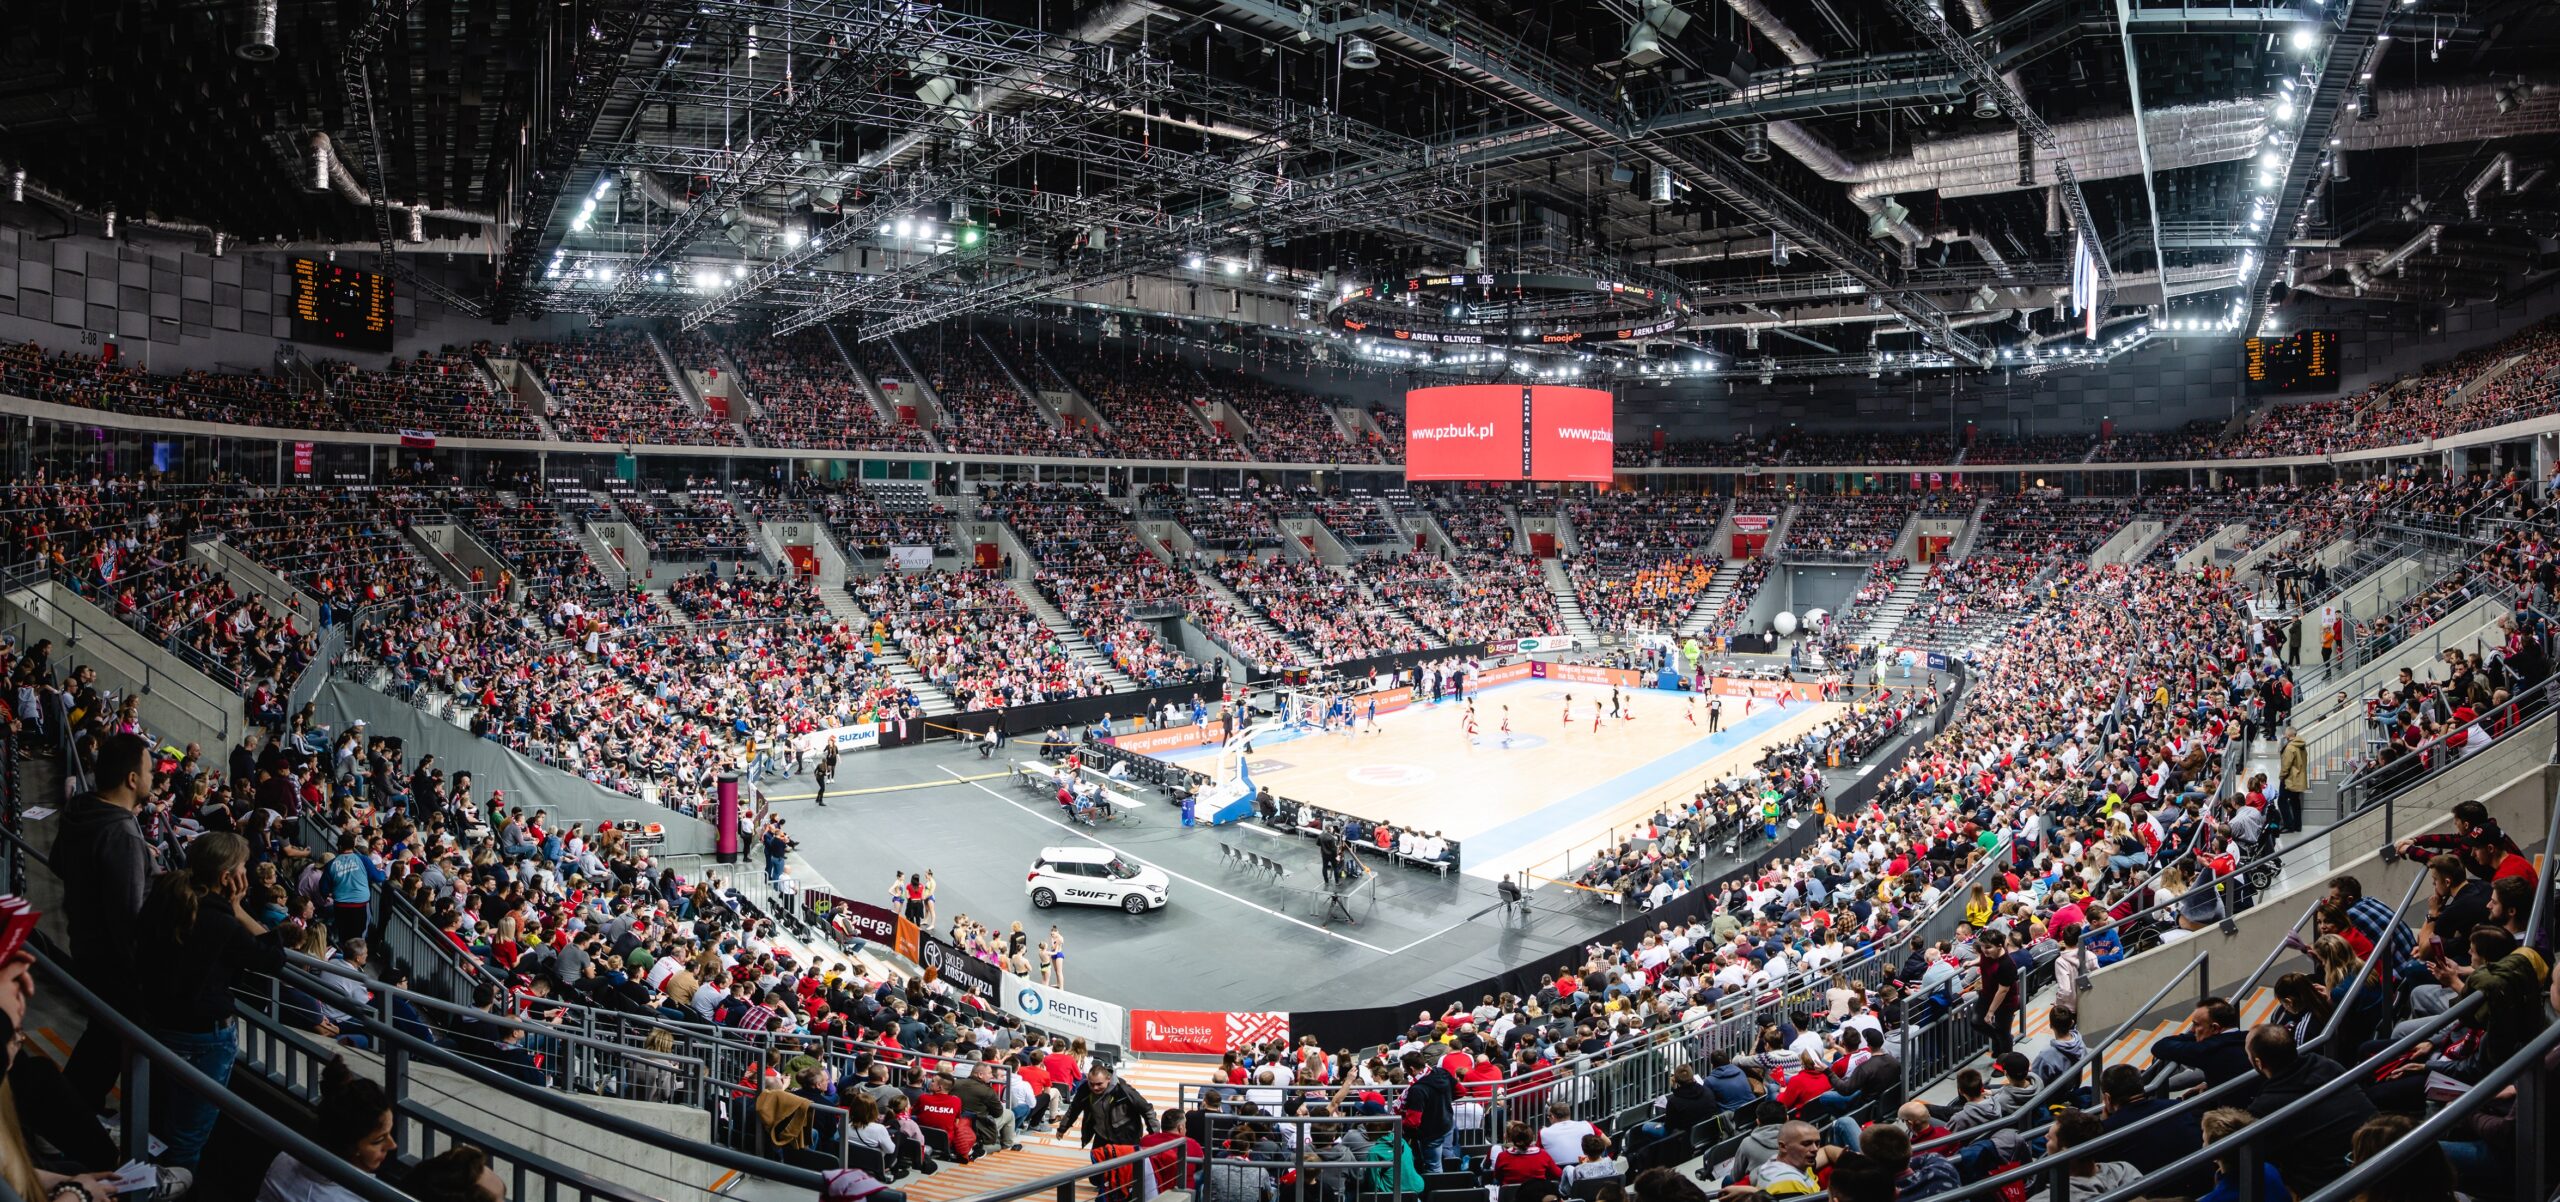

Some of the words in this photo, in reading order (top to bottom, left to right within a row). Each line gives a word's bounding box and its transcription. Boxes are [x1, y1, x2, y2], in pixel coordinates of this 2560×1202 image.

[1427, 277, 1450, 285] ISRAEL
[1477, 275, 1494, 285] 1:06
[1383, 284, 1389, 294] 2
[1408, 280, 1419, 291] 35
[1596, 281, 1611, 291] 1:06
[1624, 285, 1645, 294] POLAND
[1364, 287, 1373, 298] 32
[1661, 294, 1667, 304] 2
[1633, 326, 1654, 337] ARENA
[1656, 320, 1675, 333] GLIWICE
[81, 331, 97, 345] 3-08
[1411, 334, 1439, 342] ARENA
[1443, 335, 1481, 343] GLIWICE
[1543, 334, 1574, 343] Emocje
[1412, 422, 1494, 441] www.pzbuk.pl
[1523, 429, 1531, 471] GLIWICE
[1533, 520, 1545, 528] 1-14
[781, 526, 798, 537] 1-09
[972, 526, 986, 535] 1-10
[1496, 642, 1517, 651] Energa
[838, 730, 875, 742] SUZUKI
[1120, 737, 1151, 751] Więcej
[1152, 733, 1182, 746] energii
[1183, 733, 1194, 741] na
[1065, 888, 1117, 900] SWIFT
[945, 953, 964, 972] SKLEP
[945, 964, 993, 997] KOSZYKARZA
[1160, 1025, 1212, 1035] lubelskie
[1168, 1034, 1192, 1044] Taste
[1193, 1035, 1213, 1045] life!
[924, 1105, 954, 1114] POLSKA
